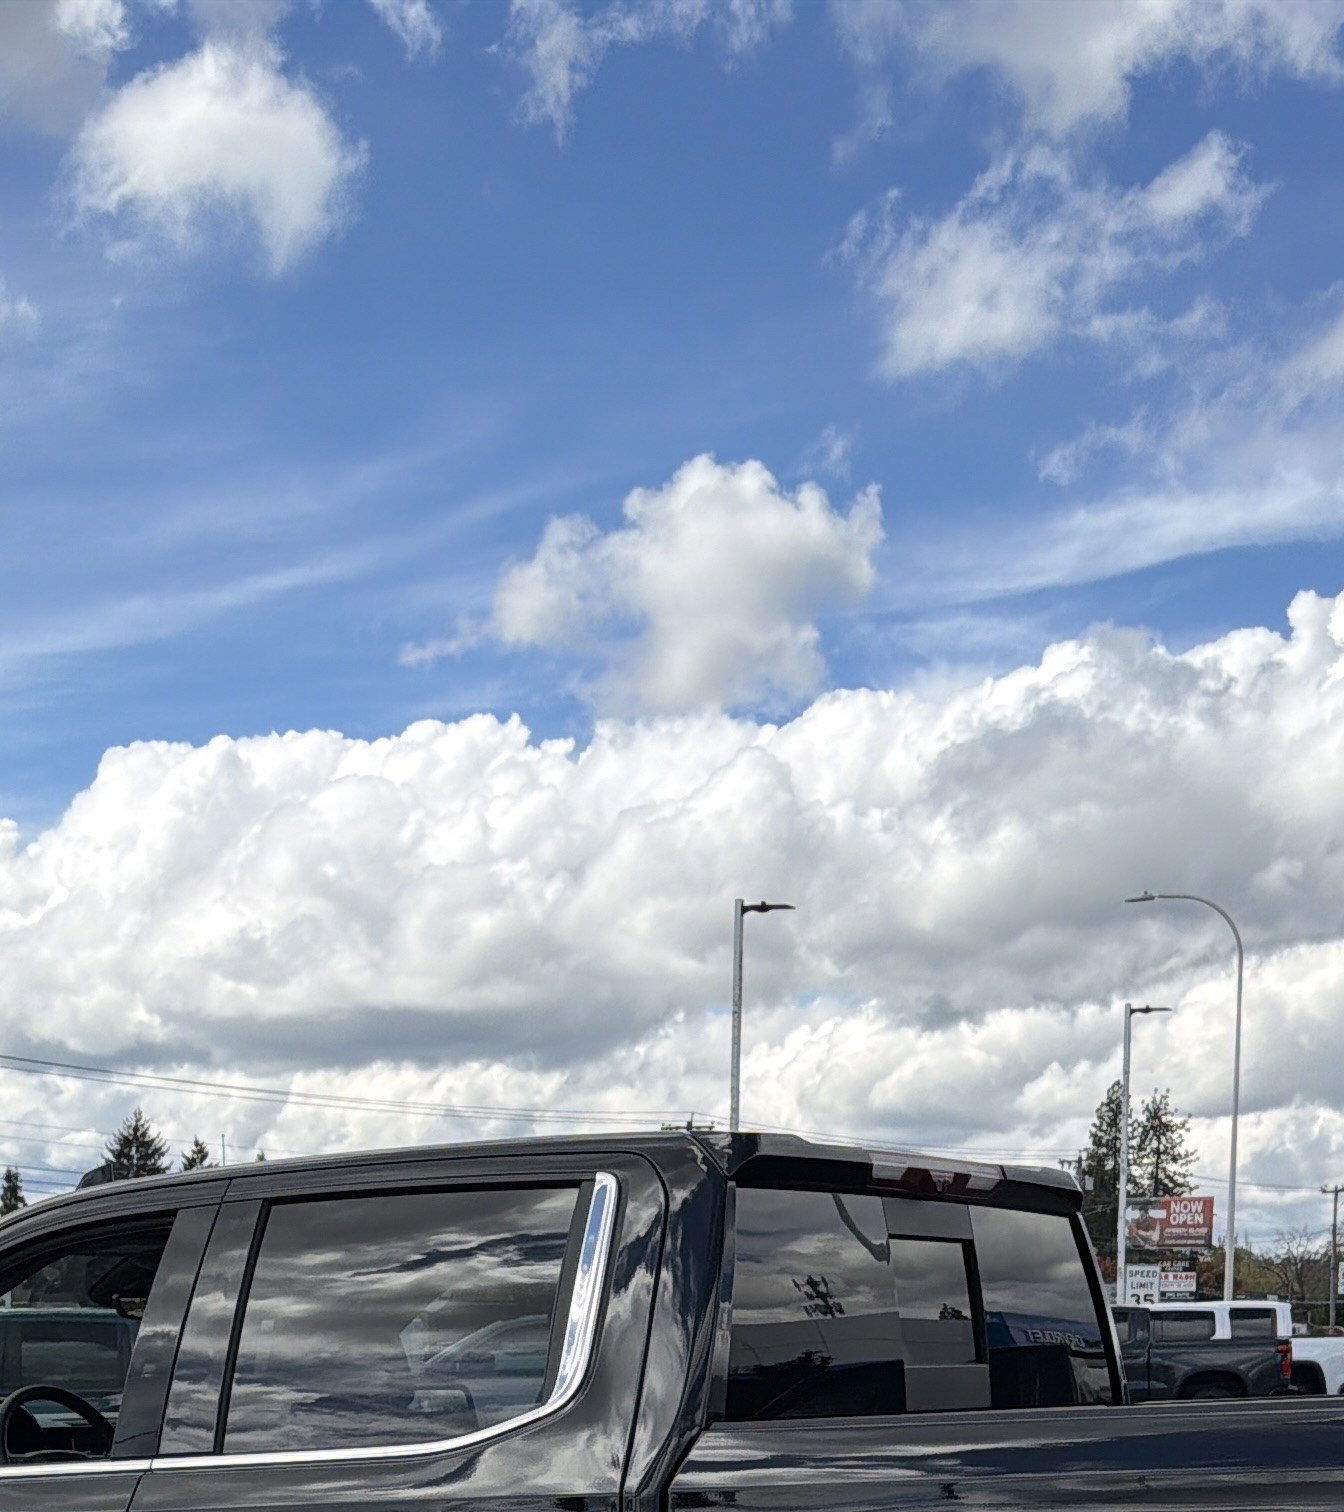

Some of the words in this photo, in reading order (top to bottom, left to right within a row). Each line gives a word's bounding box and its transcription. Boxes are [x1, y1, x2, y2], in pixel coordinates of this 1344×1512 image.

[1170, 1200, 1204, 1213] NOW
[1169, 1213, 1204, 1225] OPEN
[1128, 1269, 1158, 1279] SPEED
[1130, 1281, 1154, 1290] LIMIT
